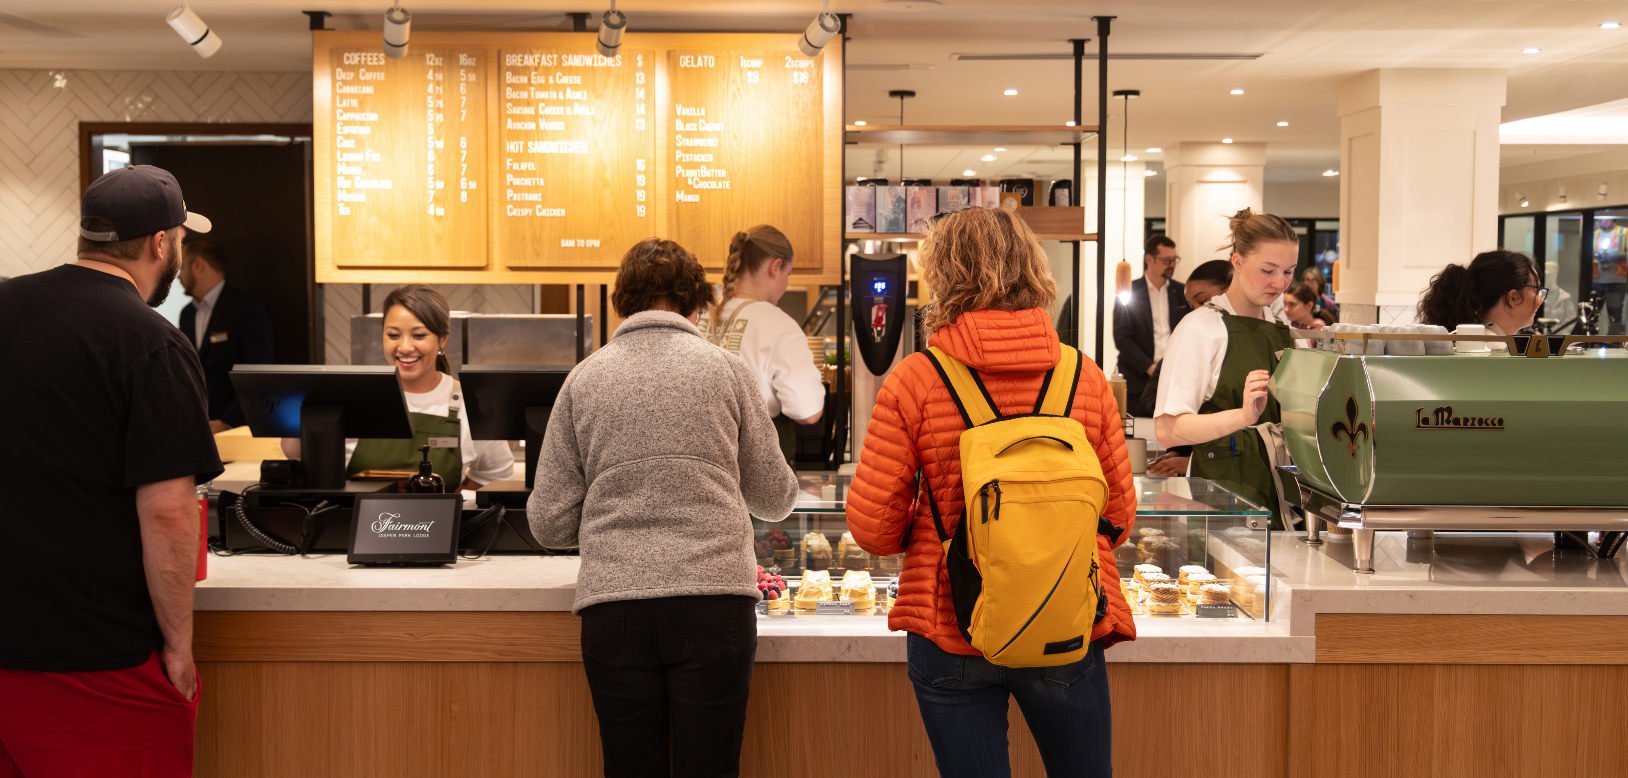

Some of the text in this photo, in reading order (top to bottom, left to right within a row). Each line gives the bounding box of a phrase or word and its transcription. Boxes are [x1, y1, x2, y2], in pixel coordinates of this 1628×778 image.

[344, 53, 385, 64] COFFEES
[506, 54, 558, 66] BREAKFAST
[562, 54, 622, 66] SANDWICHES
[680, 55, 714, 67] GELATO
[549, 76, 554, 84] &
[636, 72, 645, 84] 13
[746, 71, 808, 84] $9 $16
[460, 83, 466, 94] 6
[558, 91, 564, 99] &
[636, 88, 645, 100] 14
[460, 96, 466, 108] 7
[566, 106, 571, 115] &
[636, 103, 645, 115] 14
[460, 110, 466, 122] 7
[427, 123, 434, 135] 5
[636, 118, 645, 130] 13
[460, 137, 467, 148] 6
[506, 141, 588, 153] HOT SANDWICHES
[427, 150, 434, 162] 6
[460, 150, 466, 162] 7
[427, 163, 434, 176] 6
[460, 164, 467, 175] 7
[636, 159, 646, 171] 16
[636, 174, 646, 186] 19
[428, 190, 434, 202] 7
[461, 191, 467, 202] 8
[636, 190, 646, 202] 19
[636, 205, 646, 217] 19
[576, 239, 584, 247] TO
[1432, 405, 1504, 427] Marzocco
[371, 512, 436, 533] Fairmont
